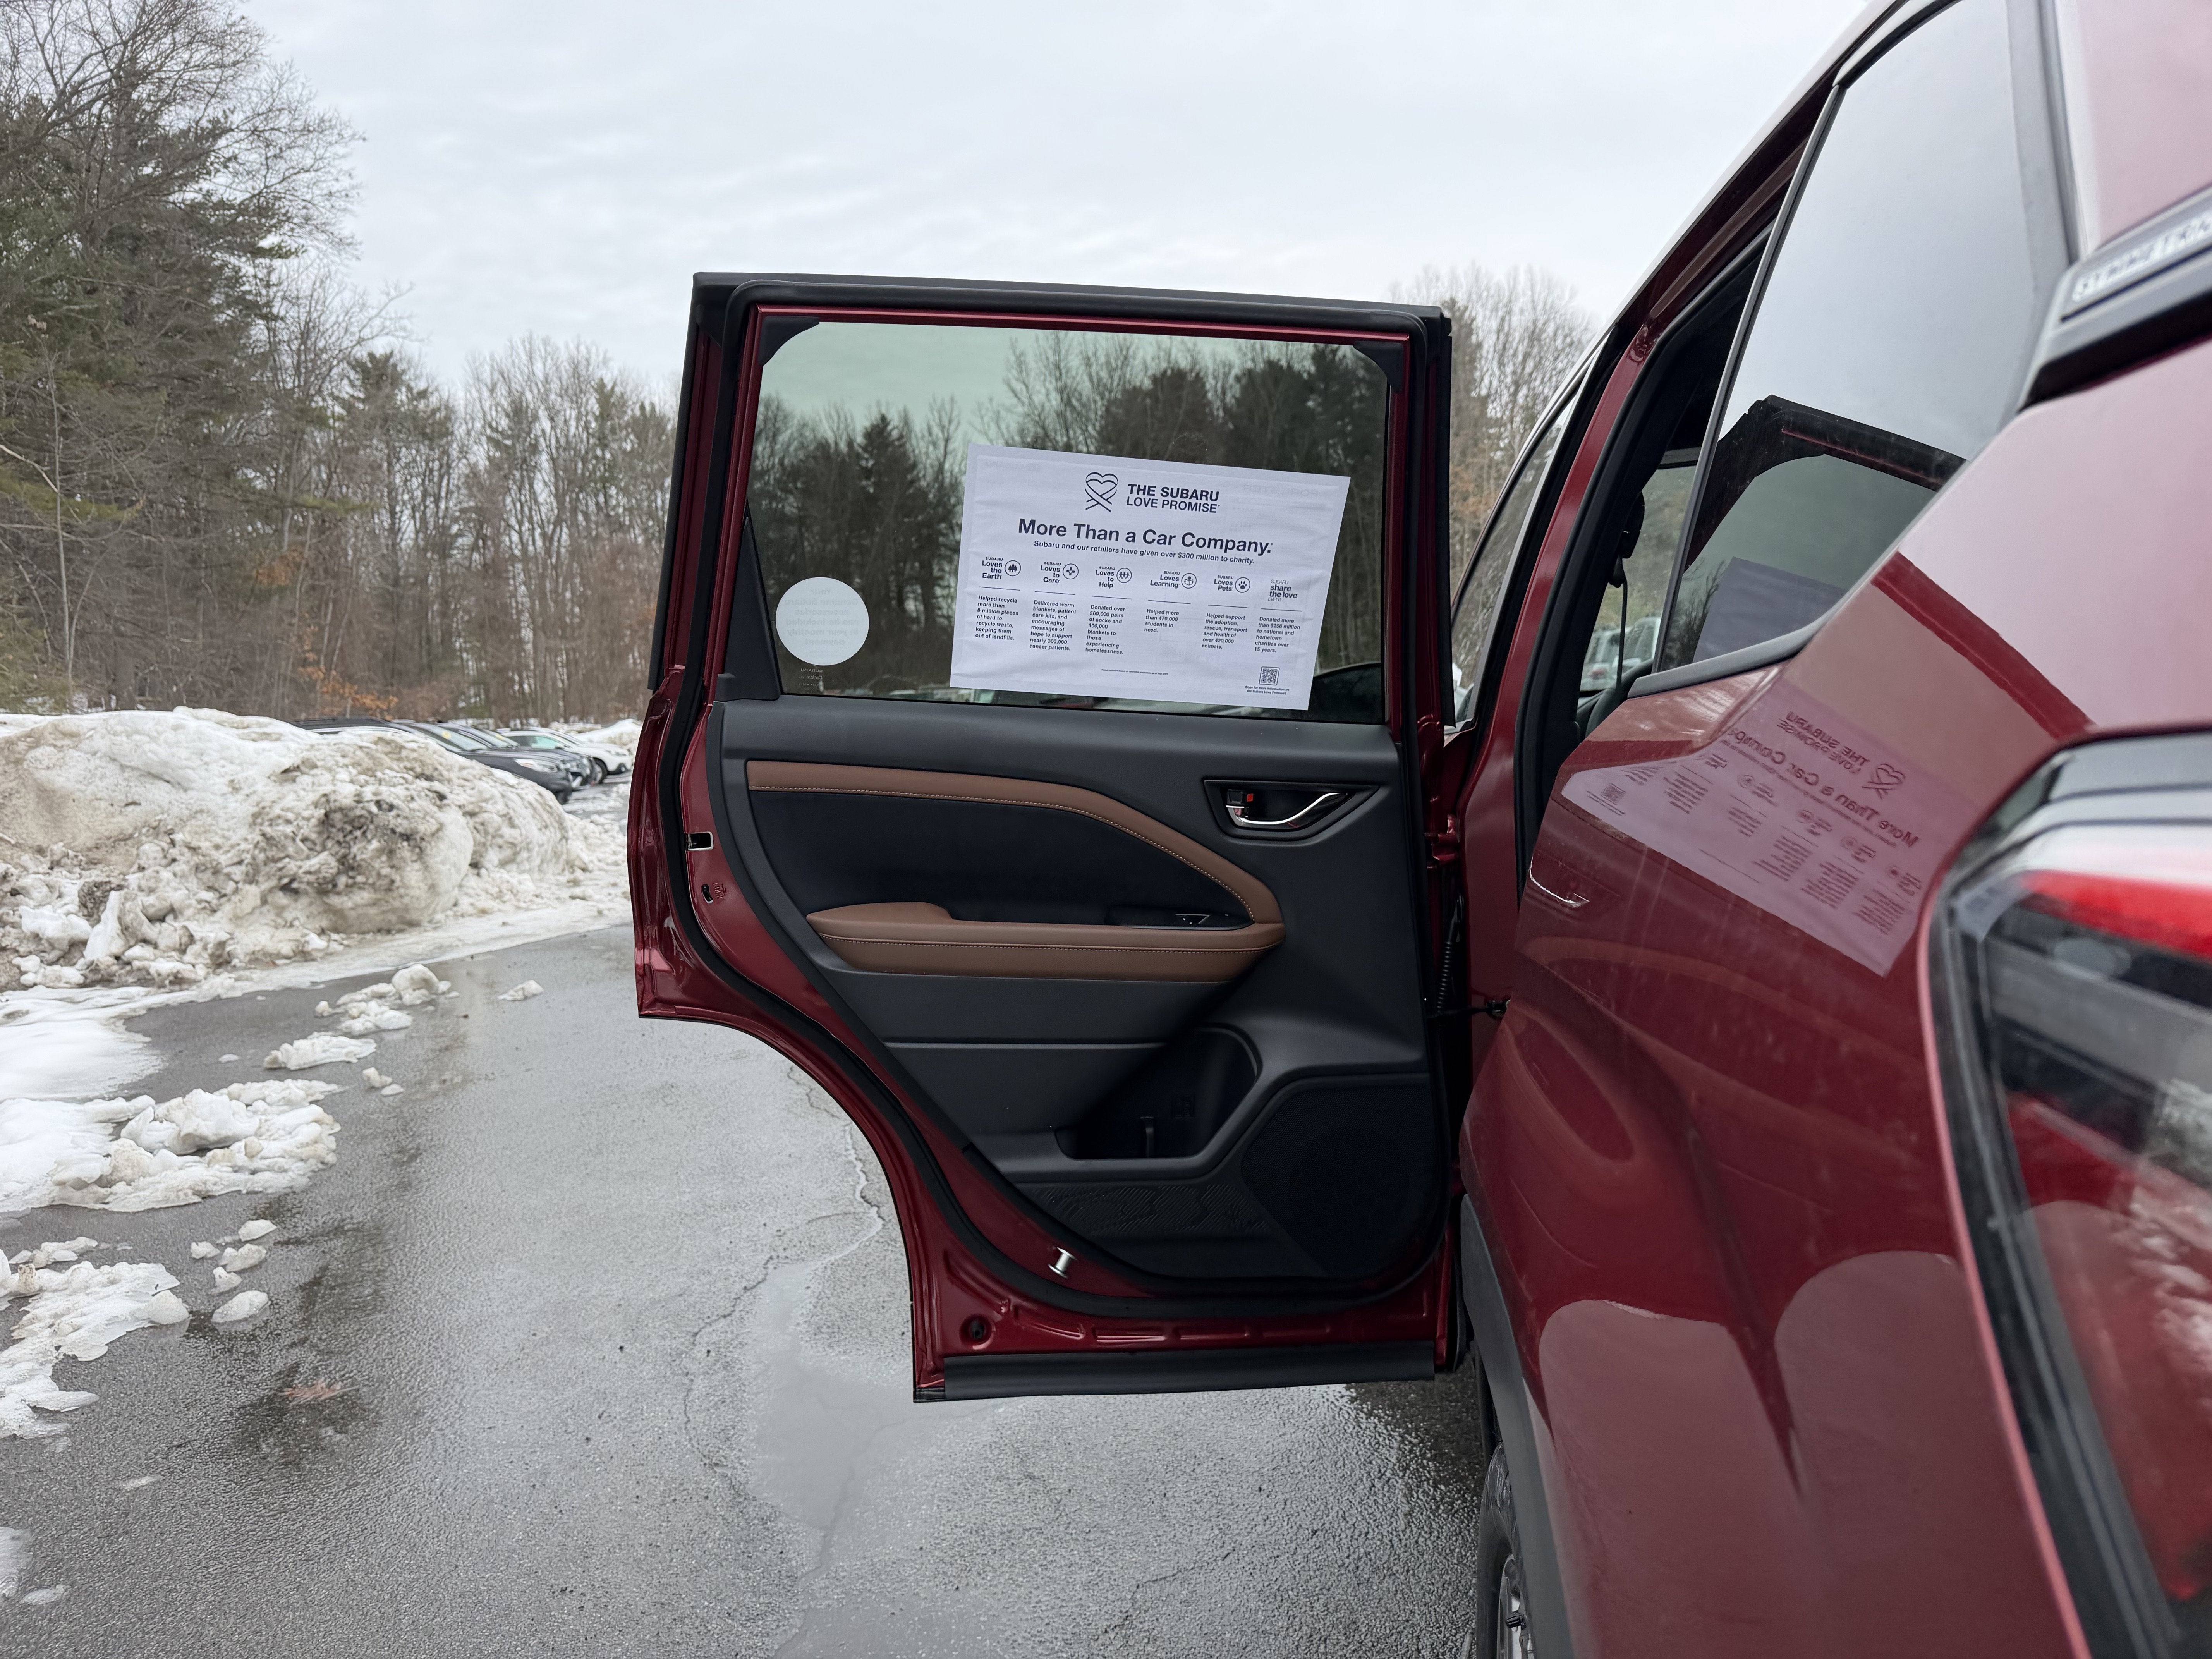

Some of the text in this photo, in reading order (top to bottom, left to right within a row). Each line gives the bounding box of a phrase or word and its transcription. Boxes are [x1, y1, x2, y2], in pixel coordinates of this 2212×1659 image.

[1128, 484, 1219, 501] THE SUBARU
[1127, 496, 1158, 508] LOVE
[1018, 518, 1067, 537] More
[1073, 523, 1119, 541] Than
[1125, 531, 1136, 543] a
[1143, 529, 1176, 546] Car
[1230, 556, 1254, 565] charity.
[1150, 580, 1179, 589] Learning
